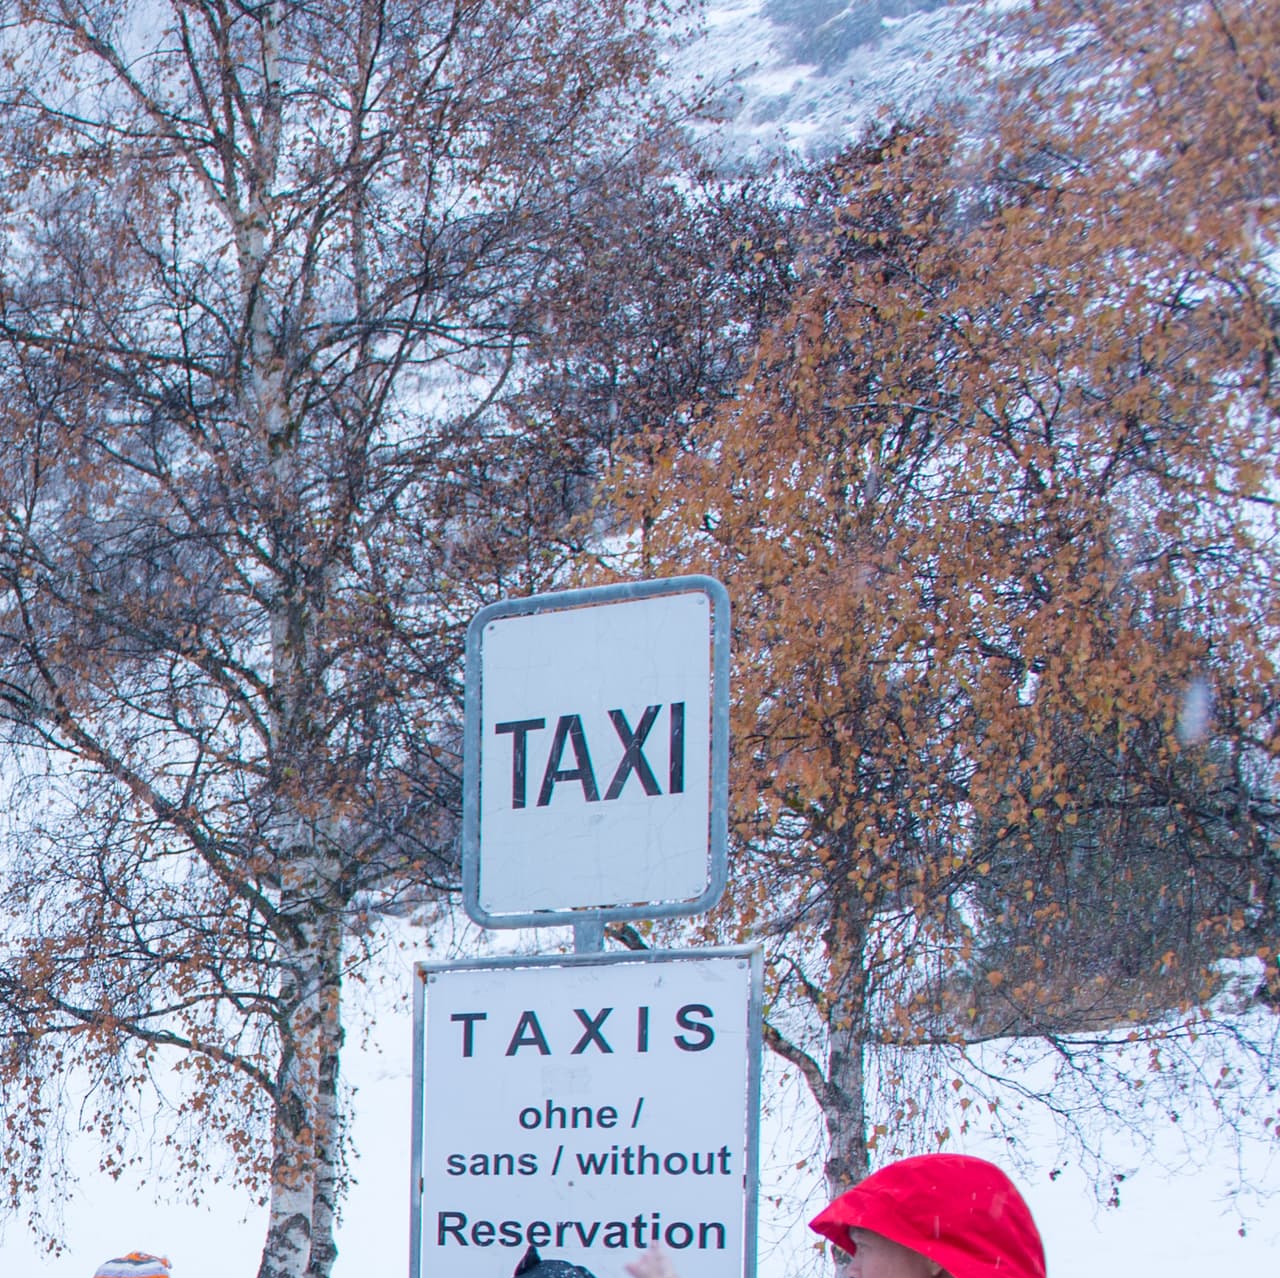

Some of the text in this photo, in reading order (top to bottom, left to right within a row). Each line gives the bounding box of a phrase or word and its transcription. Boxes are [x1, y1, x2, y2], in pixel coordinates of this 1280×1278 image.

[495, 702, 686, 810] TAXI
[449, 1003, 716, 1058] TAXIS
[518, 1099, 619, 1130] ohne
[445, 1150, 539, 1177] sans
[575, 1144, 732, 1176] without
[437, 1211, 727, 1250] Reservation
